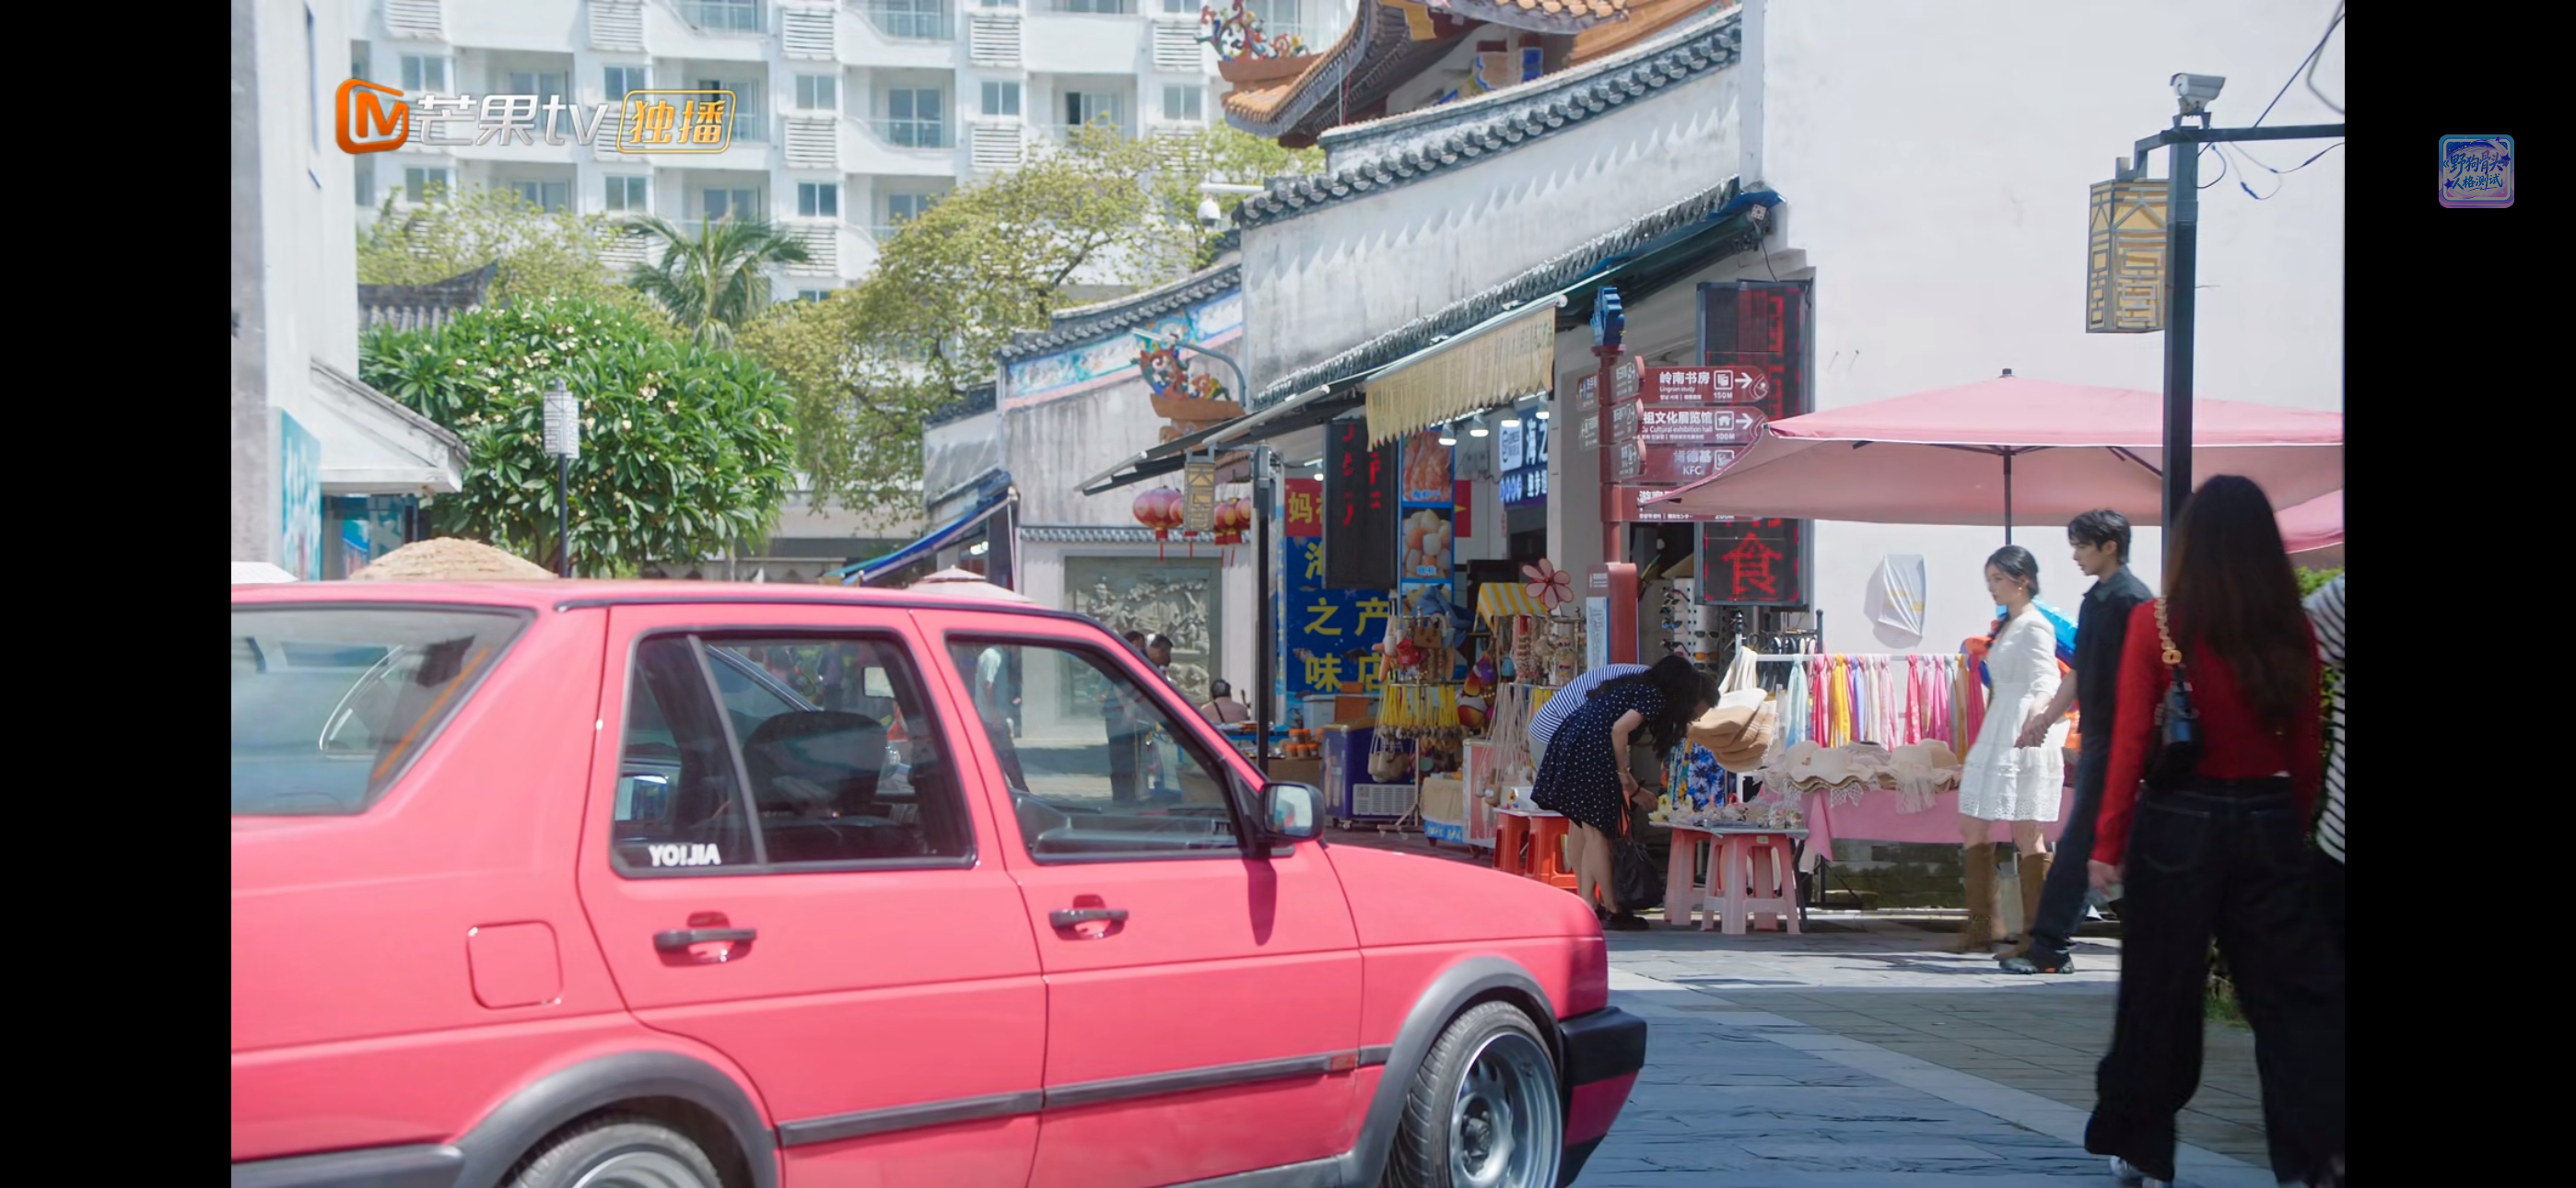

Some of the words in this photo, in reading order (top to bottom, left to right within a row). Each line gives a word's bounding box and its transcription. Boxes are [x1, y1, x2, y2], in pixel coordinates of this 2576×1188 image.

[1659, 371, 1711, 385] 岭南书房
[1673, 449, 1712, 463] 肯德基
[1682, 465, 1702, 475] KFC
[1722, 531, 1783, 596] 食
